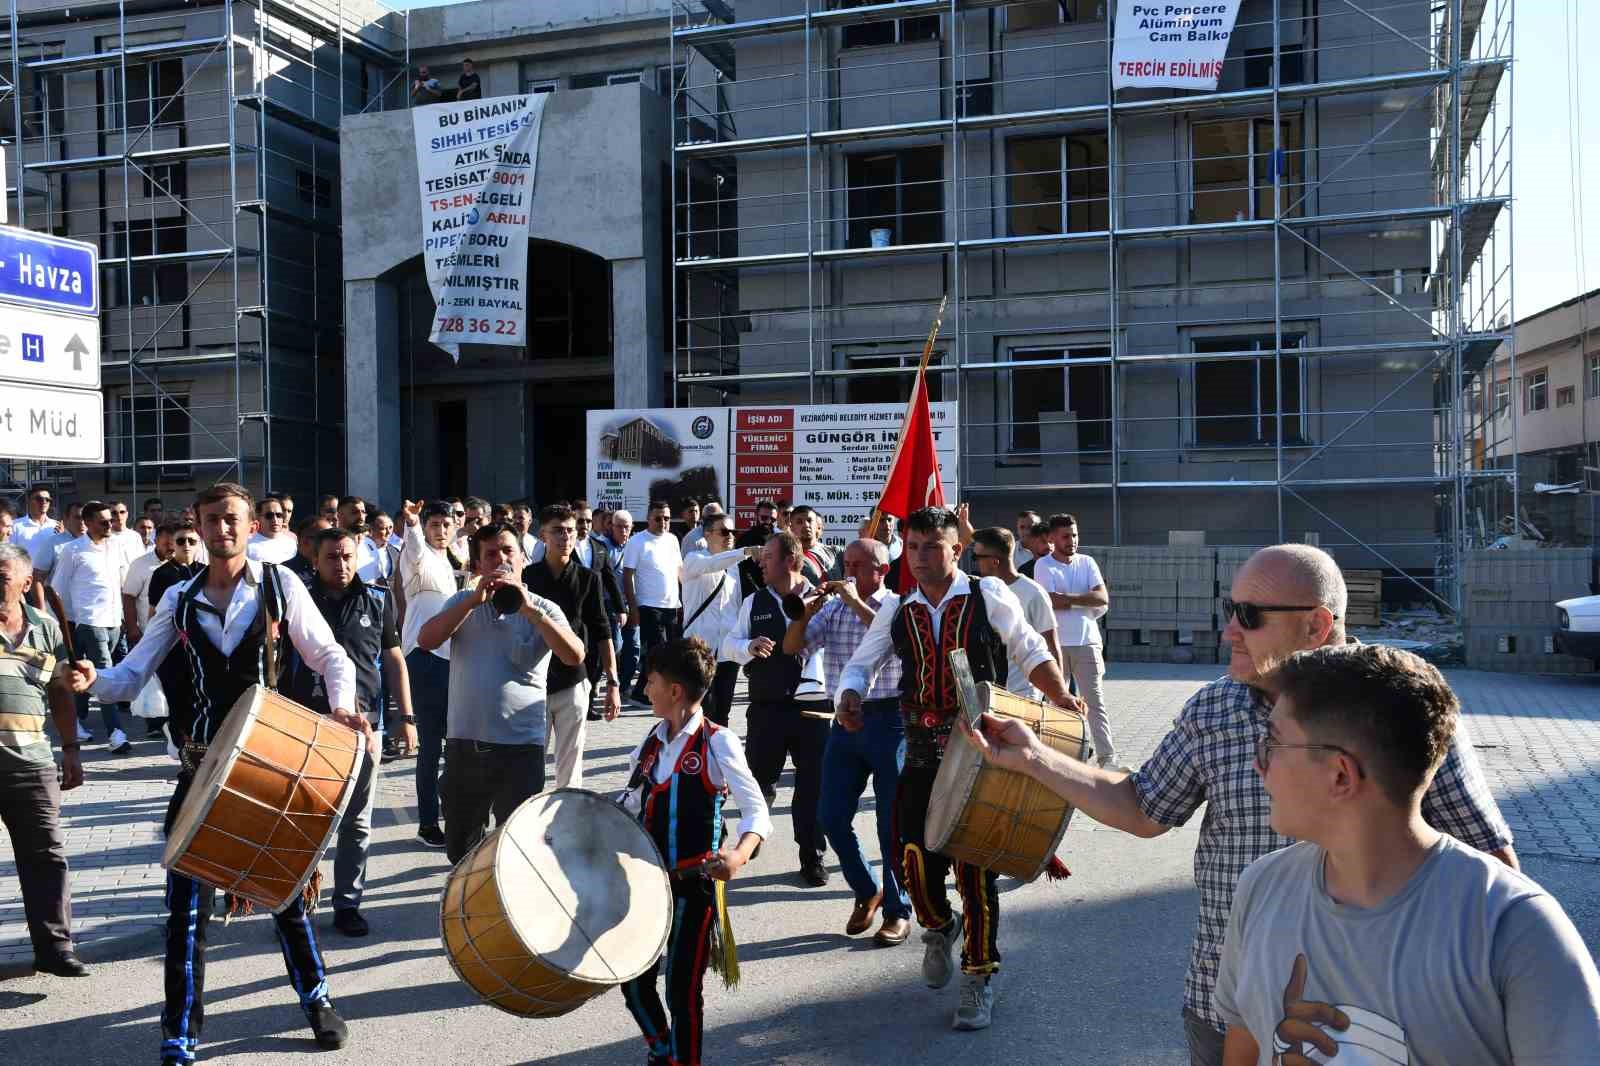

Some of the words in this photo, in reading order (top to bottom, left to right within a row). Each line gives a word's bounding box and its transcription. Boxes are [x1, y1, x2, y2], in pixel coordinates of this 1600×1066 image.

[1133, 5, 1159, 16] Pvc
[1165, 5, 1227, 16] Pencere
[1139, 17, 1223, 30] Alüminyum
[1149, 31, 1182, 42] Cam
[1119, 58, 1166, 77] TERCİH
[439, 112, 459, 128] BU
[463, 97, 528, 123] BİNANIN
[431, 128, 473, 150] SIHHİ
[455, 147, 490, 167] ATIK
[425, 168, 491, 193] TESİSAT
[493, 171, 526, 186] 9001
[468, 232, 509, 248] BORU
[19, 252, 82, 295] Havza
[478, 298, 524, 311] BAYKAL
[438, 317, 464, 334] 728
[468, 317, 491, 334] 36
[495, 319, 517, 336] 22
[29, 407, 83, 438] Müd.
[806, 430, 876, 443] GÜNGÖR
[871, 443, 895, 451] GÜNG
[827, 490, 853, 501] MÜH.
[862, 490, 881, 502] ŞEN
